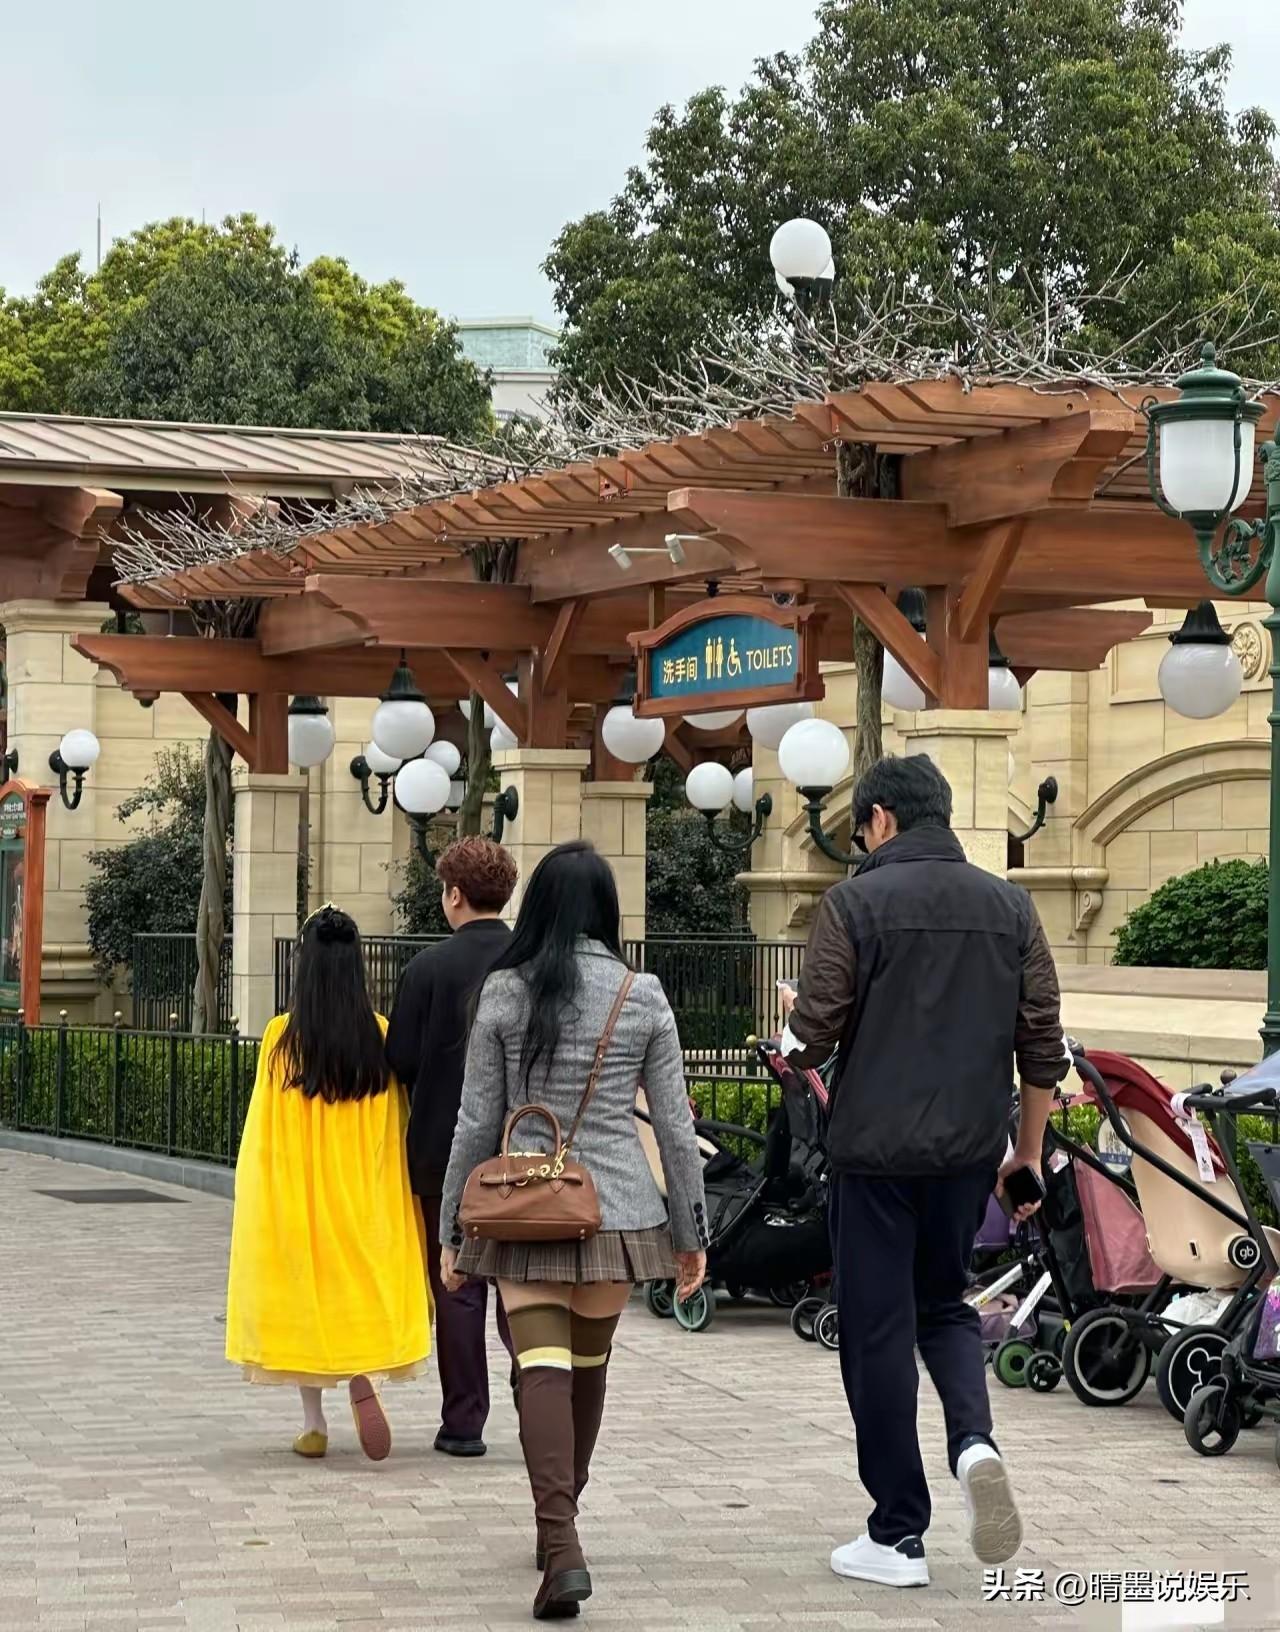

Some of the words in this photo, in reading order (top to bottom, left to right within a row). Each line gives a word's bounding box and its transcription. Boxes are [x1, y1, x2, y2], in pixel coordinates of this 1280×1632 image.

[663, 656, 698, 684] 洗手间
[746, 645, 793, 671] TOILETS
[1240, 1245, 1254, 1260] gb
